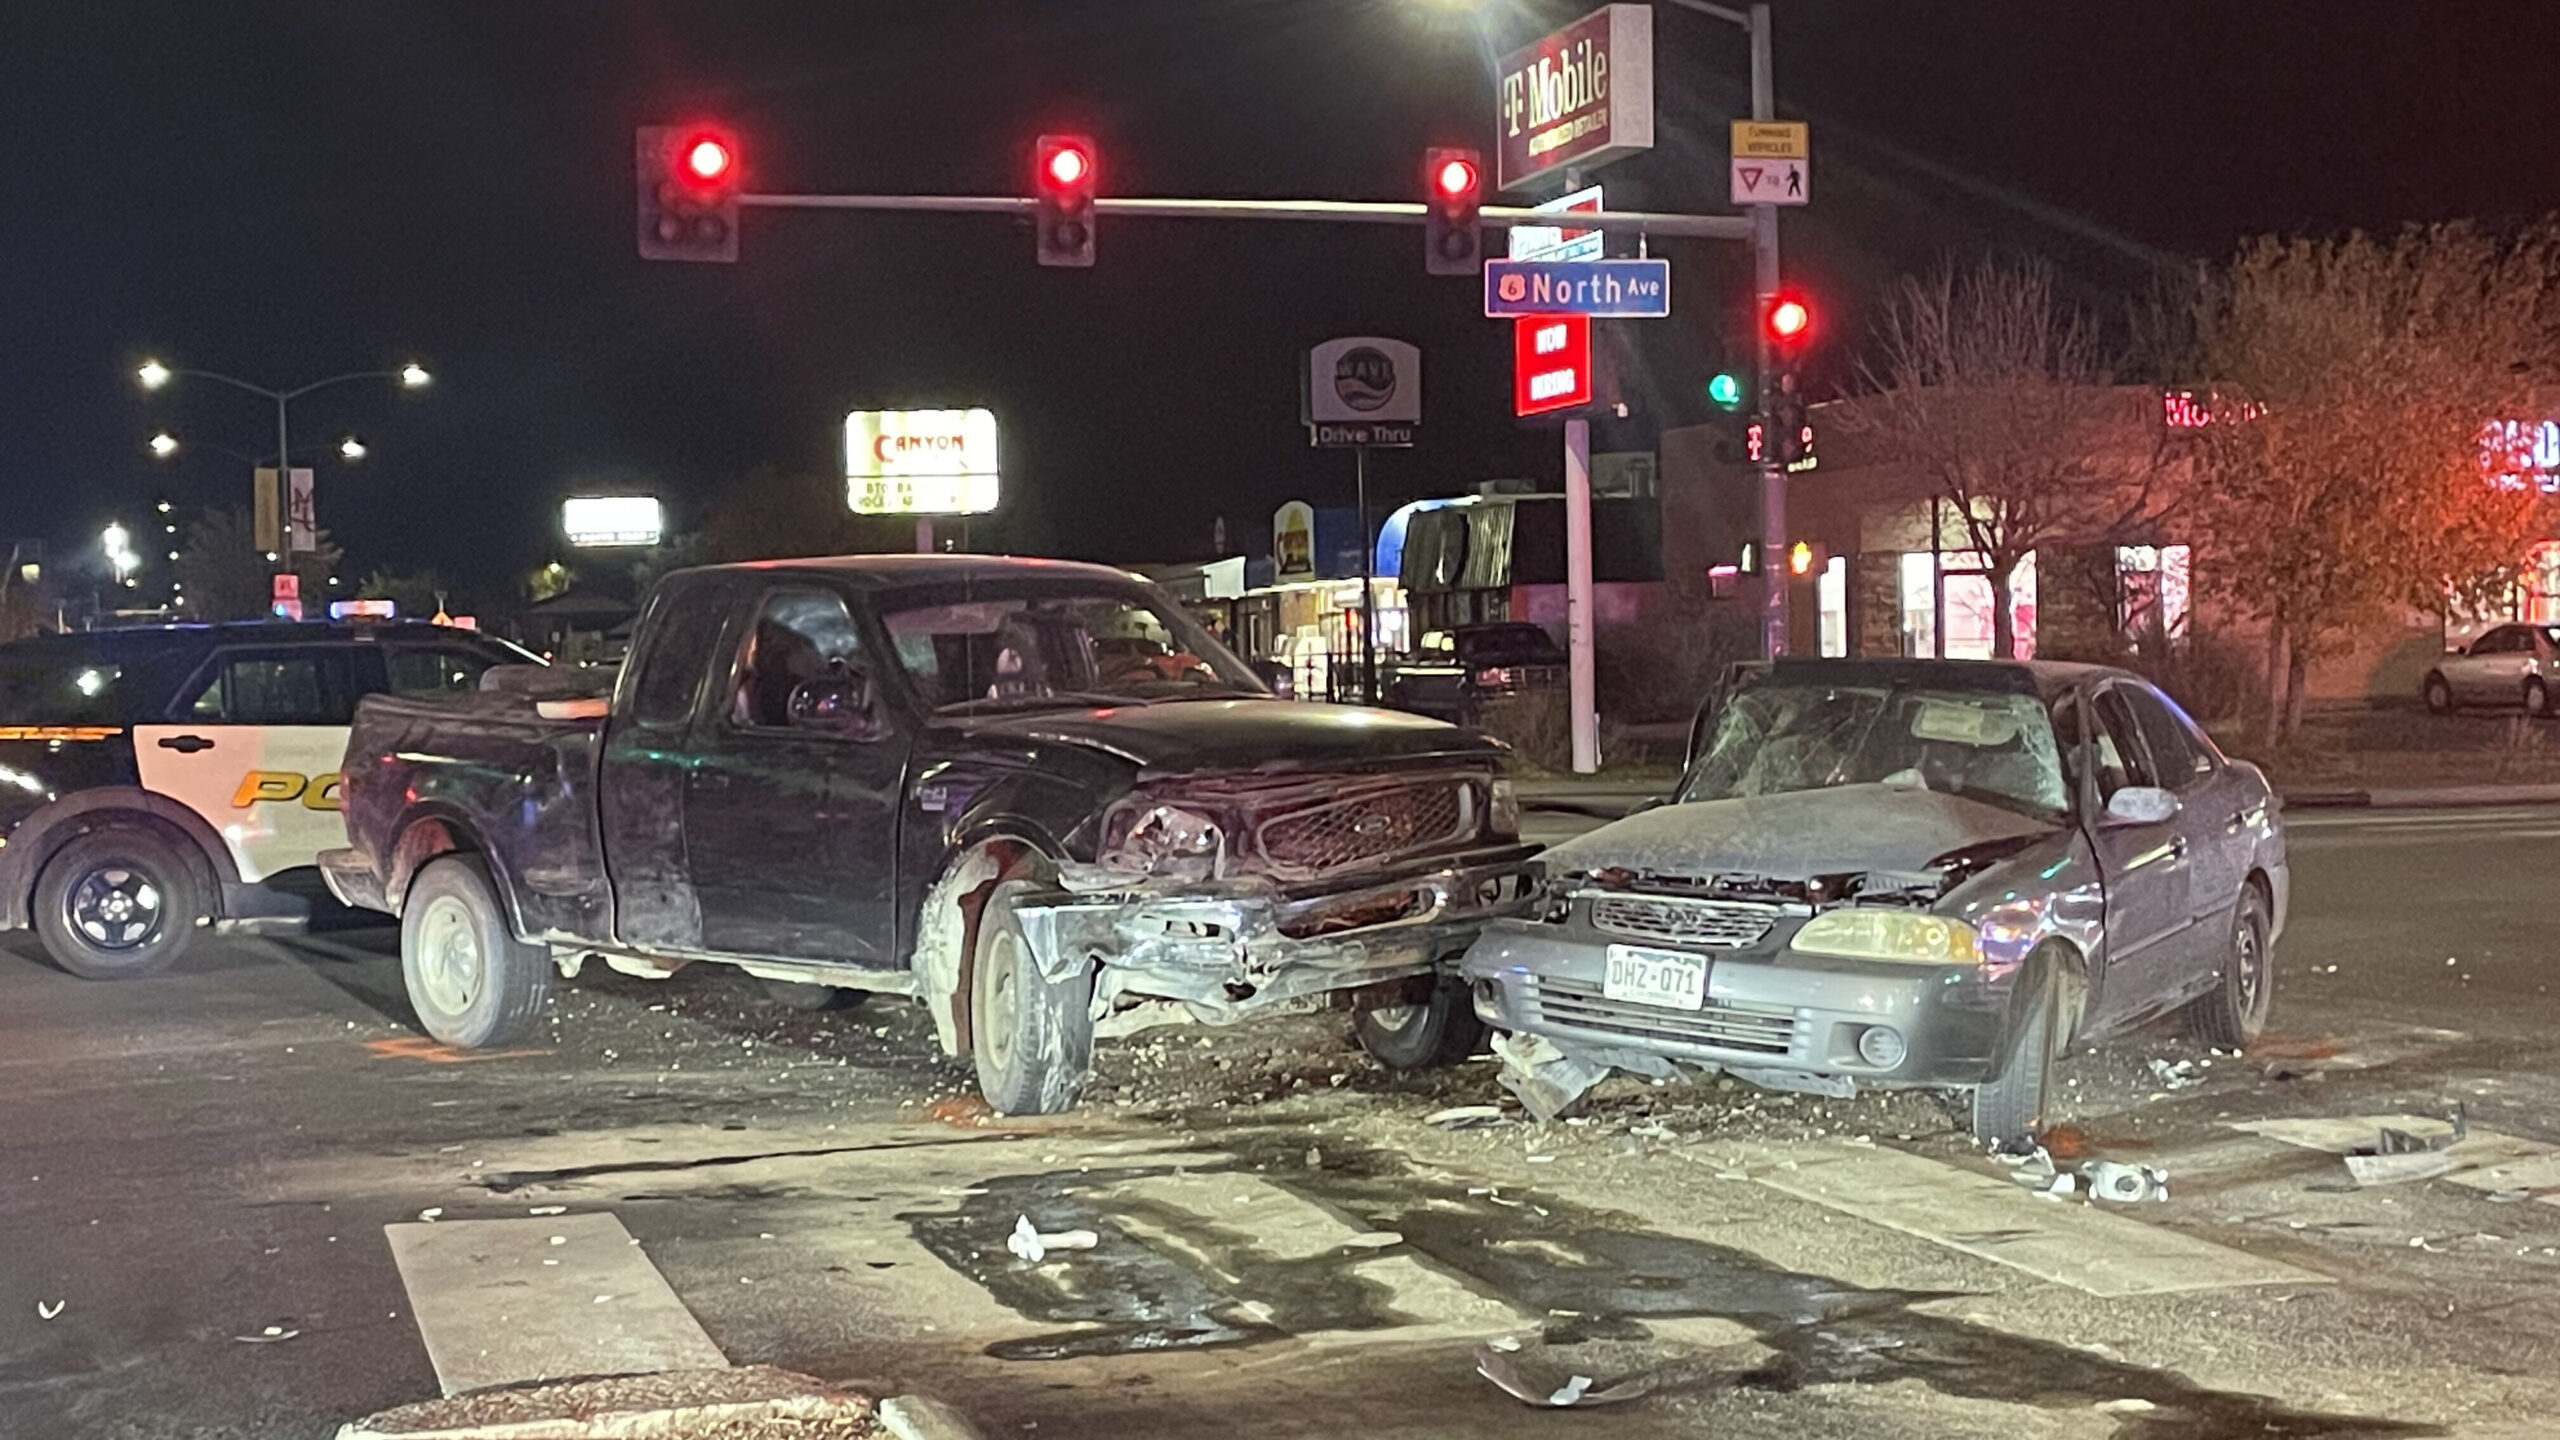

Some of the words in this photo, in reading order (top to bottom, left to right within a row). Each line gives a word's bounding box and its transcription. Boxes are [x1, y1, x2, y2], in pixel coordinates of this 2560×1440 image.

[1766, 175, 1780, 186] TO
[1507, 281, 1518, 297] 6
[1533, 273, 1622, 304] North
[1627, 277, 1660, 297] Ave
[1536, 324, 1567, 355] NOW
[873, 434, 964, 463] CANYON
[1320, 426, 1368, 443] Drive
[1373, 425, 1412, 443] Thru
